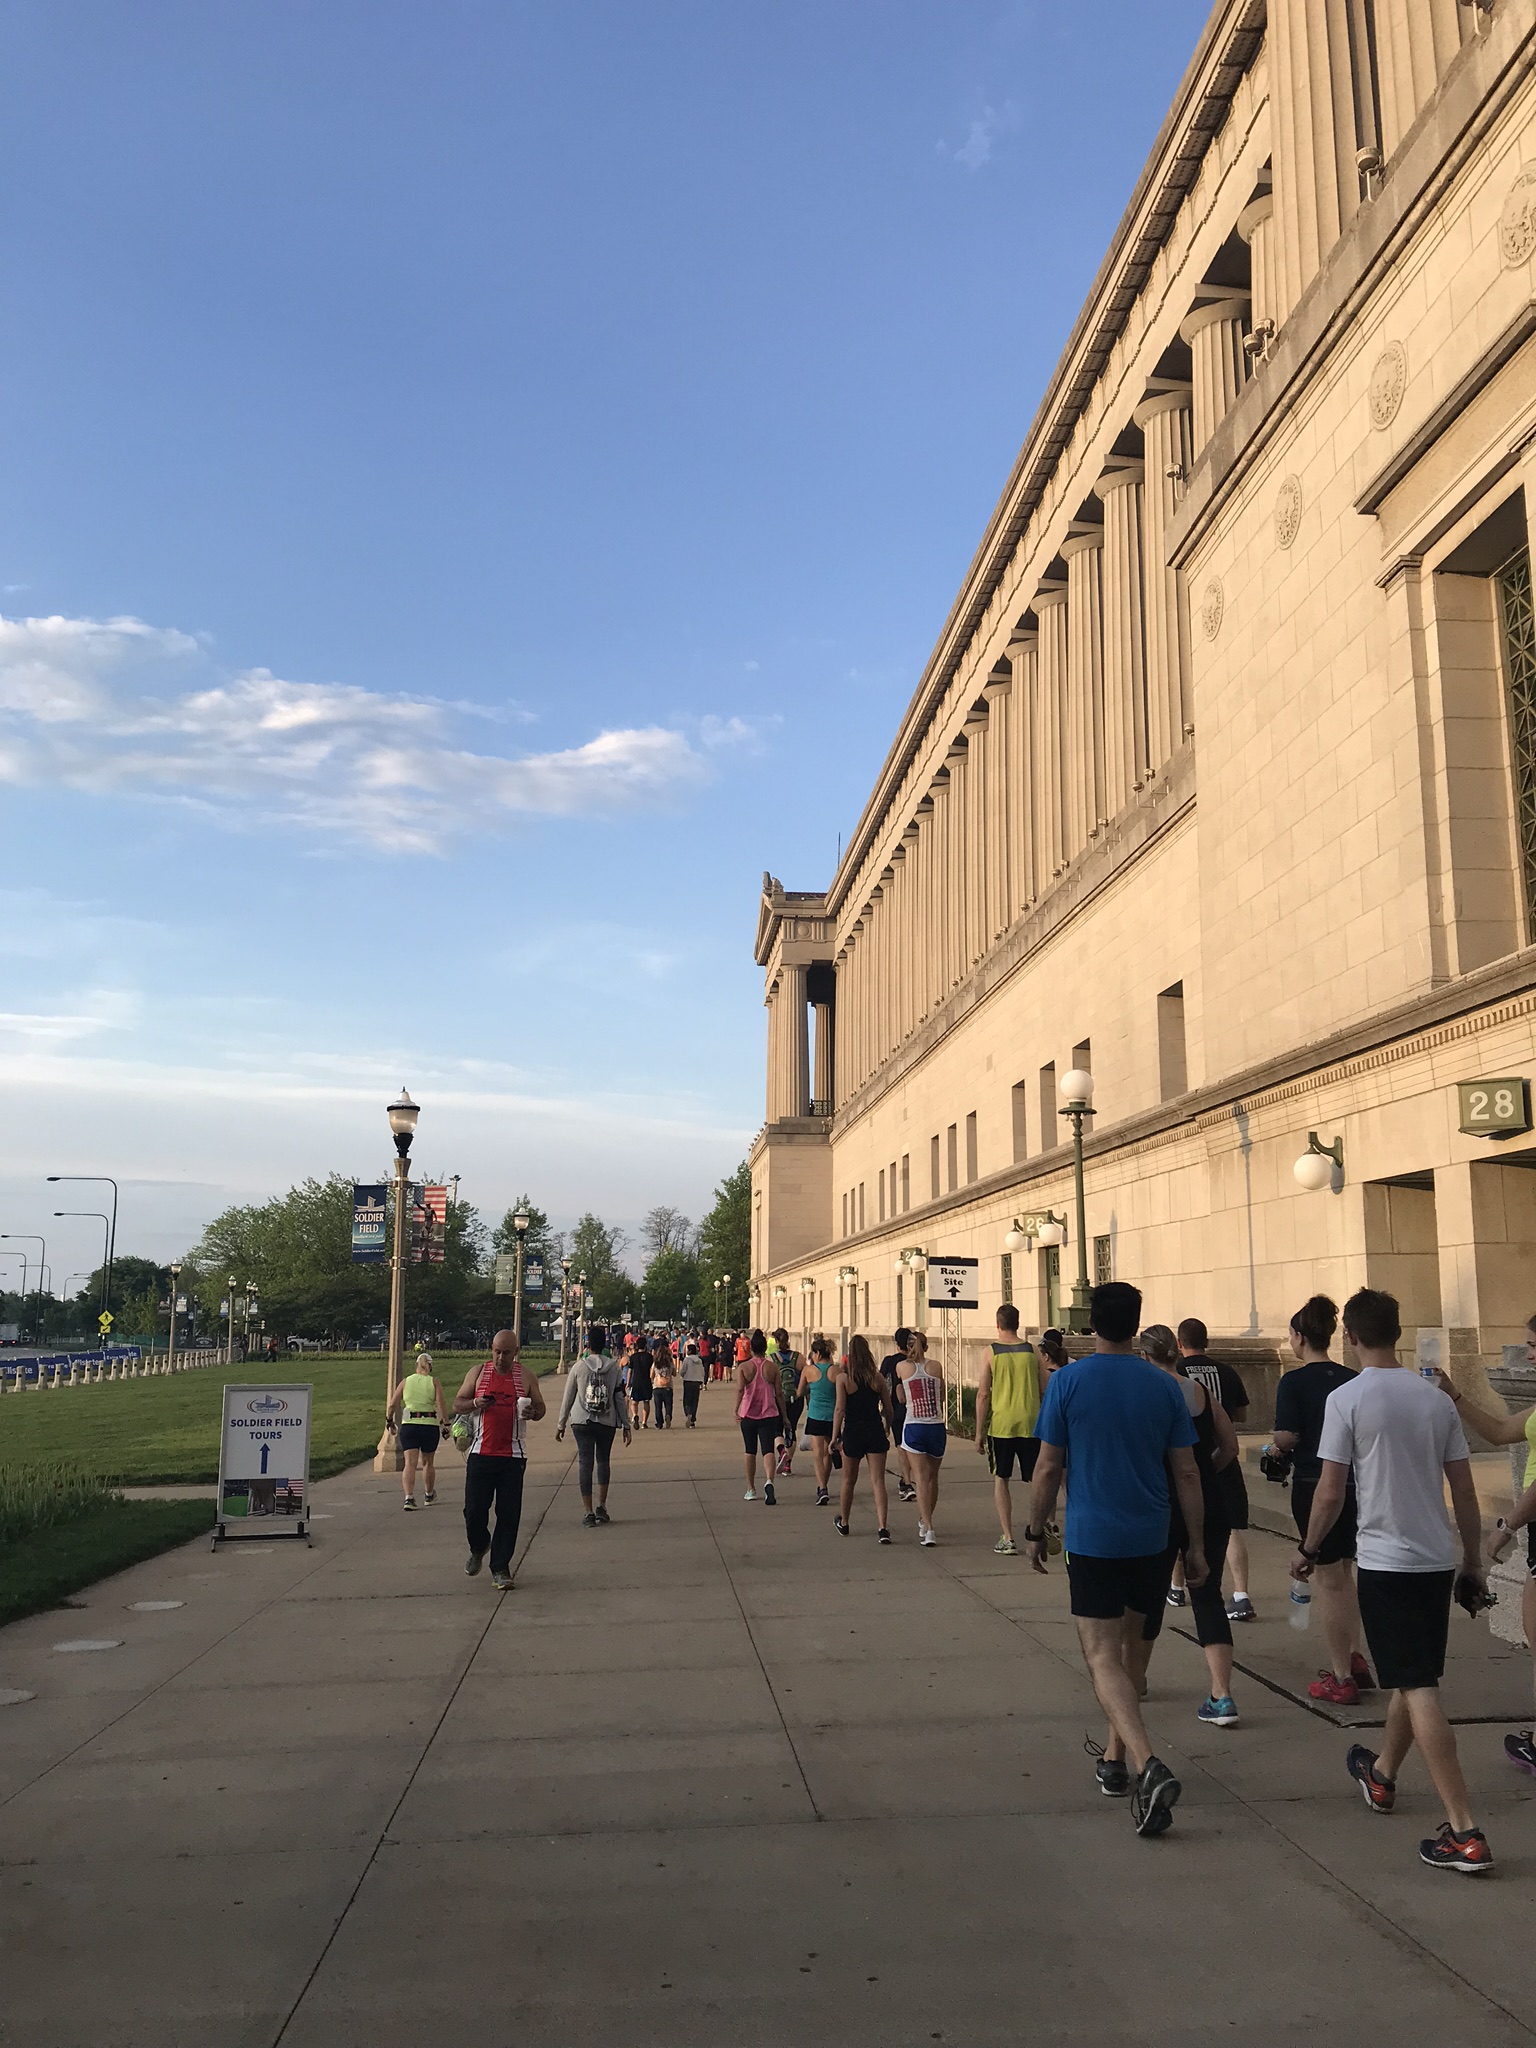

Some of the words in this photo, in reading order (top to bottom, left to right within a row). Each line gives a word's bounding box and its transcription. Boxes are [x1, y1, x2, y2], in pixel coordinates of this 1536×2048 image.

[1469, 1089, 1514, 1121] 28
[354, 1212, 385, 1223] SOLDIER
[359, 1223, 379, 1234] FIELD
[1026, 1216, 1044, 1232] 26
[940, 1267, 967, 1276] Race
[943, 1277, 964, 1286] Site
[1185, 1365, 1218, 1374] FREEDOM
[230, 1418, 273, 1428] SOLDIER
[275, 1418, 303, 1427] FIELD
[249, 1431, 283, 1440] TOURS
